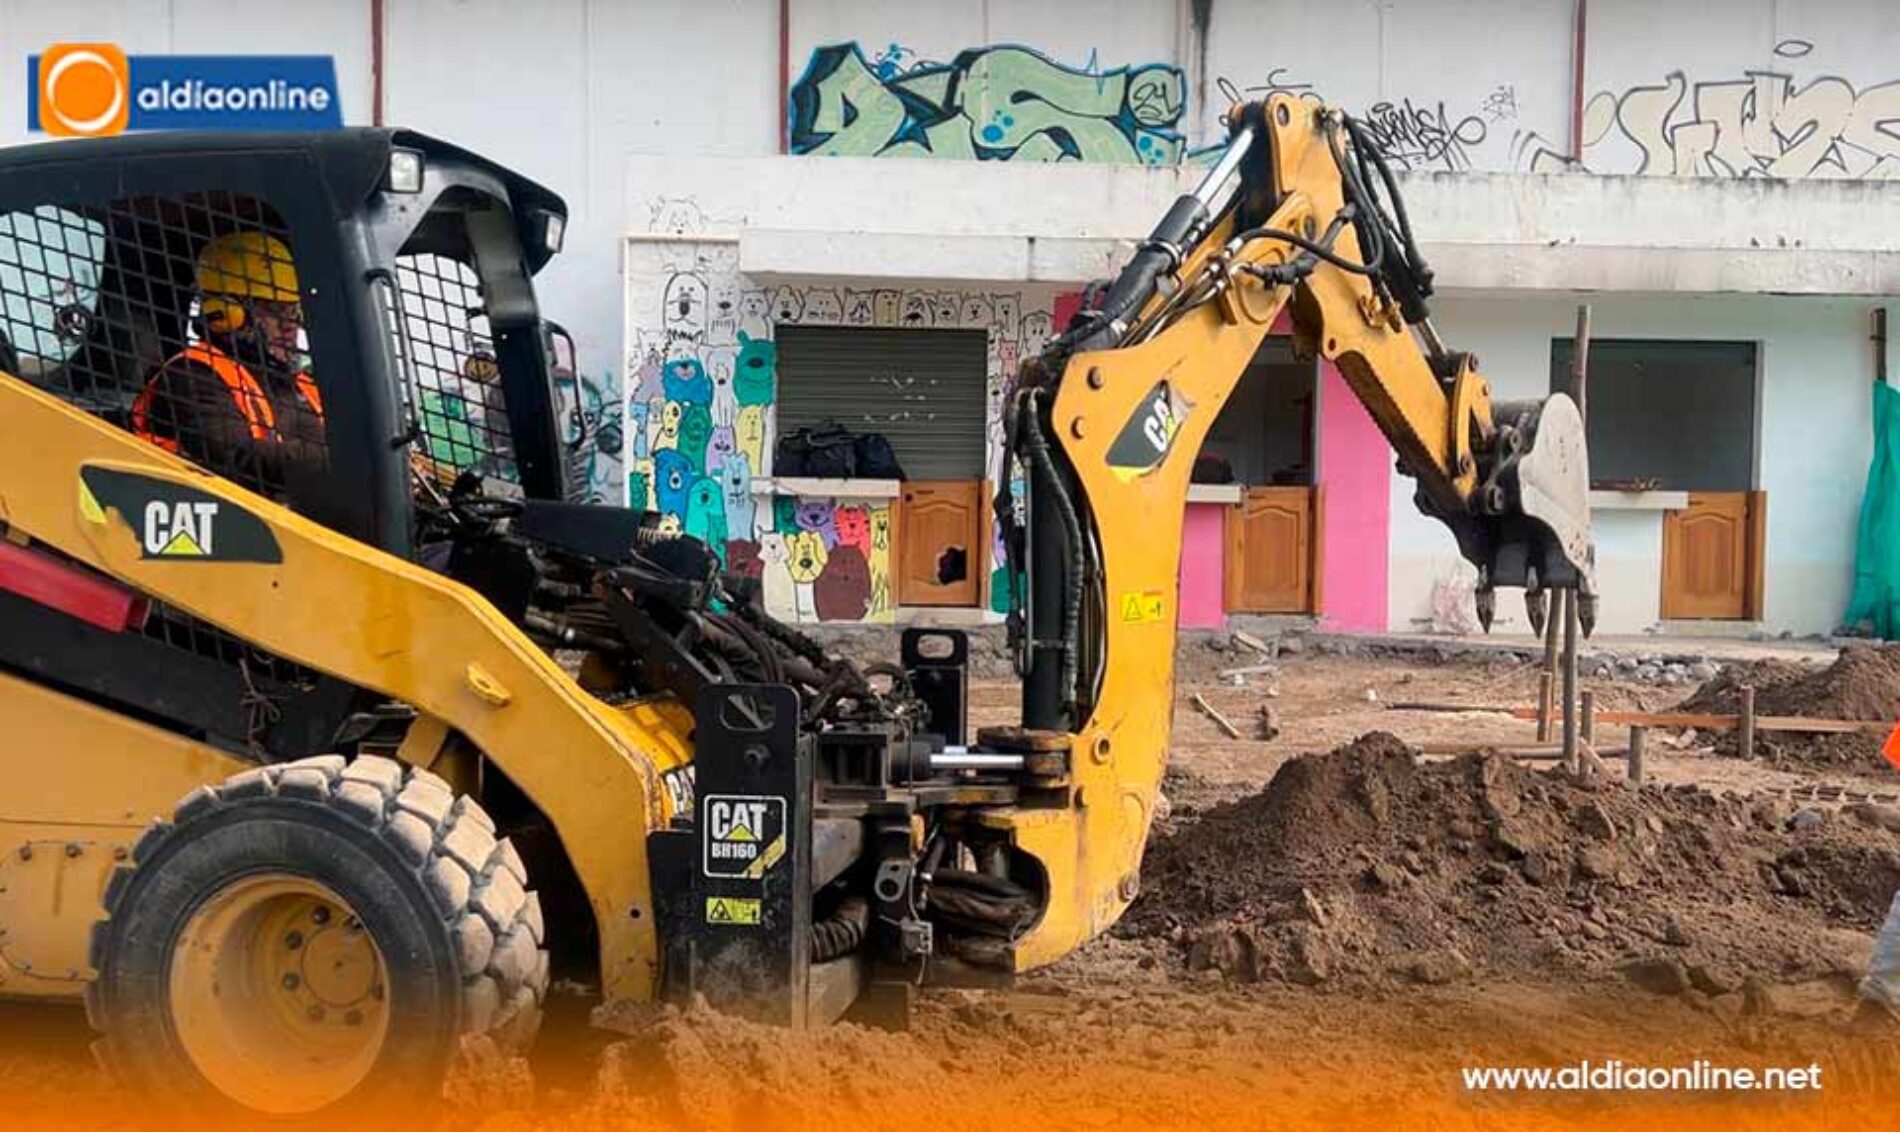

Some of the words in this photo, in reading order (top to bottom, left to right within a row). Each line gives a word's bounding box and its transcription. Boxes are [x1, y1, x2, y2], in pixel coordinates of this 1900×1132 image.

[144, 500, 219, 555] CAT
[711, 801, 768, 842] CAT
[711, 842, 758, 859] BH160
